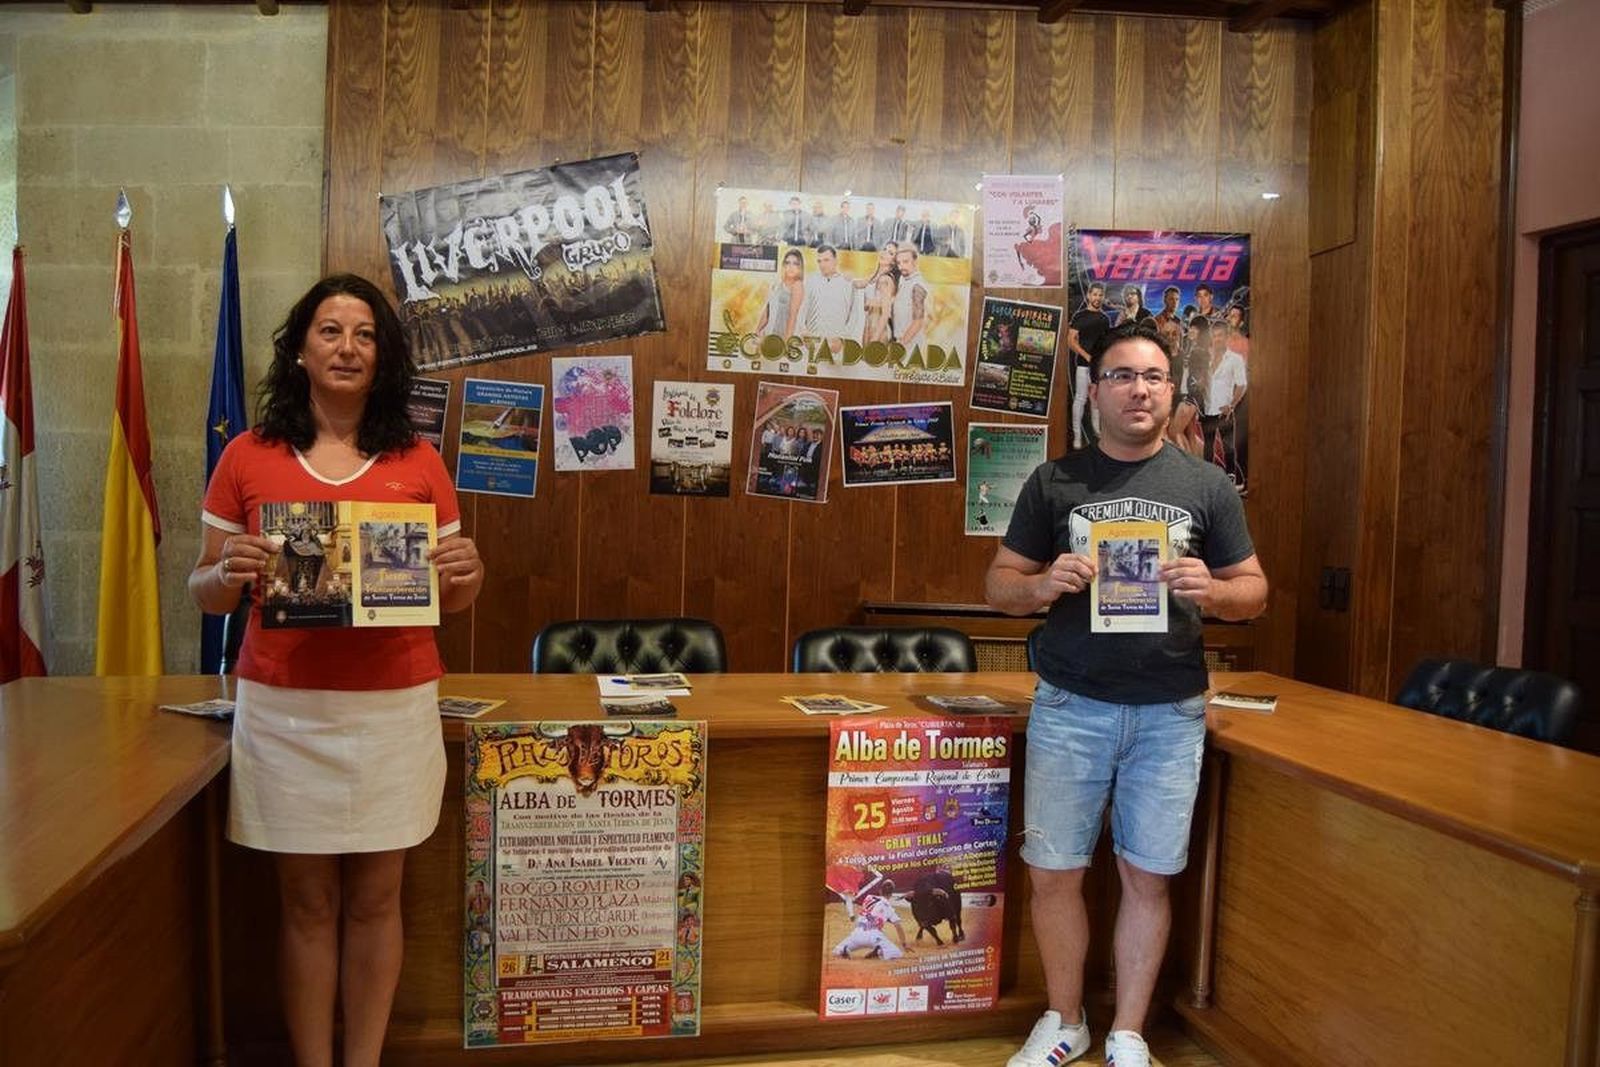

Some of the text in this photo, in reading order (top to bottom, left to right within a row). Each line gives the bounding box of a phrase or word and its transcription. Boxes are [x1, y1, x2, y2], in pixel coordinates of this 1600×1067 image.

[391, 172, 650, 304] LIVERPOOL
[562, 231, 631, 271] GRUPO
[739, 332, 835, 366] COSTA
[840, 337, 963, 371] DORADA
[667, 400, 724, 421] Folclore
[1081, 501, 1183, 523] PREMIUM QUALITY
[834, 729, 1008, 762] Alba de Tormes
[839, 772, 869, 785] Primer
[925, 769, 958, 788] Regional
[499, 789, 676, 811] ALBA DE TORMES
[890, 798, 916, 806] Viernes
[853, 801, 887, 831] 25
[890, 806, 914, 816] Agosto
[642, 832, 676, 844] FLAMENCO
[896, 848, 916, 859] Final
[916, 848, 928, 858] del
[929, 844, 962, 856] Concurso
[963, 843, 973, 852] de
[974, 840, 998, 850] Cortes
[546, 856, 567, 868] ANA
[570, 855, 604, 868] ISABEL
[608, 854, 648, 867] VICENTE
[892, 861, 910, 872] para
[562, 878, 641, 894] ROMERO
[500, 893, 641, 912] FERNANDO PLAZA
[584, 924, 641, 938] HOYOS
[502, 962, 516, 974] 26
[546, 956, 655, 971] SALAMENCO
[502, 990, 573, 1002] TRADICIONALES
[574, 986, 625, 998] ENCIERROS
[626, 986, 632, 995] Y
[828, 994, 856, 1006] Caser
